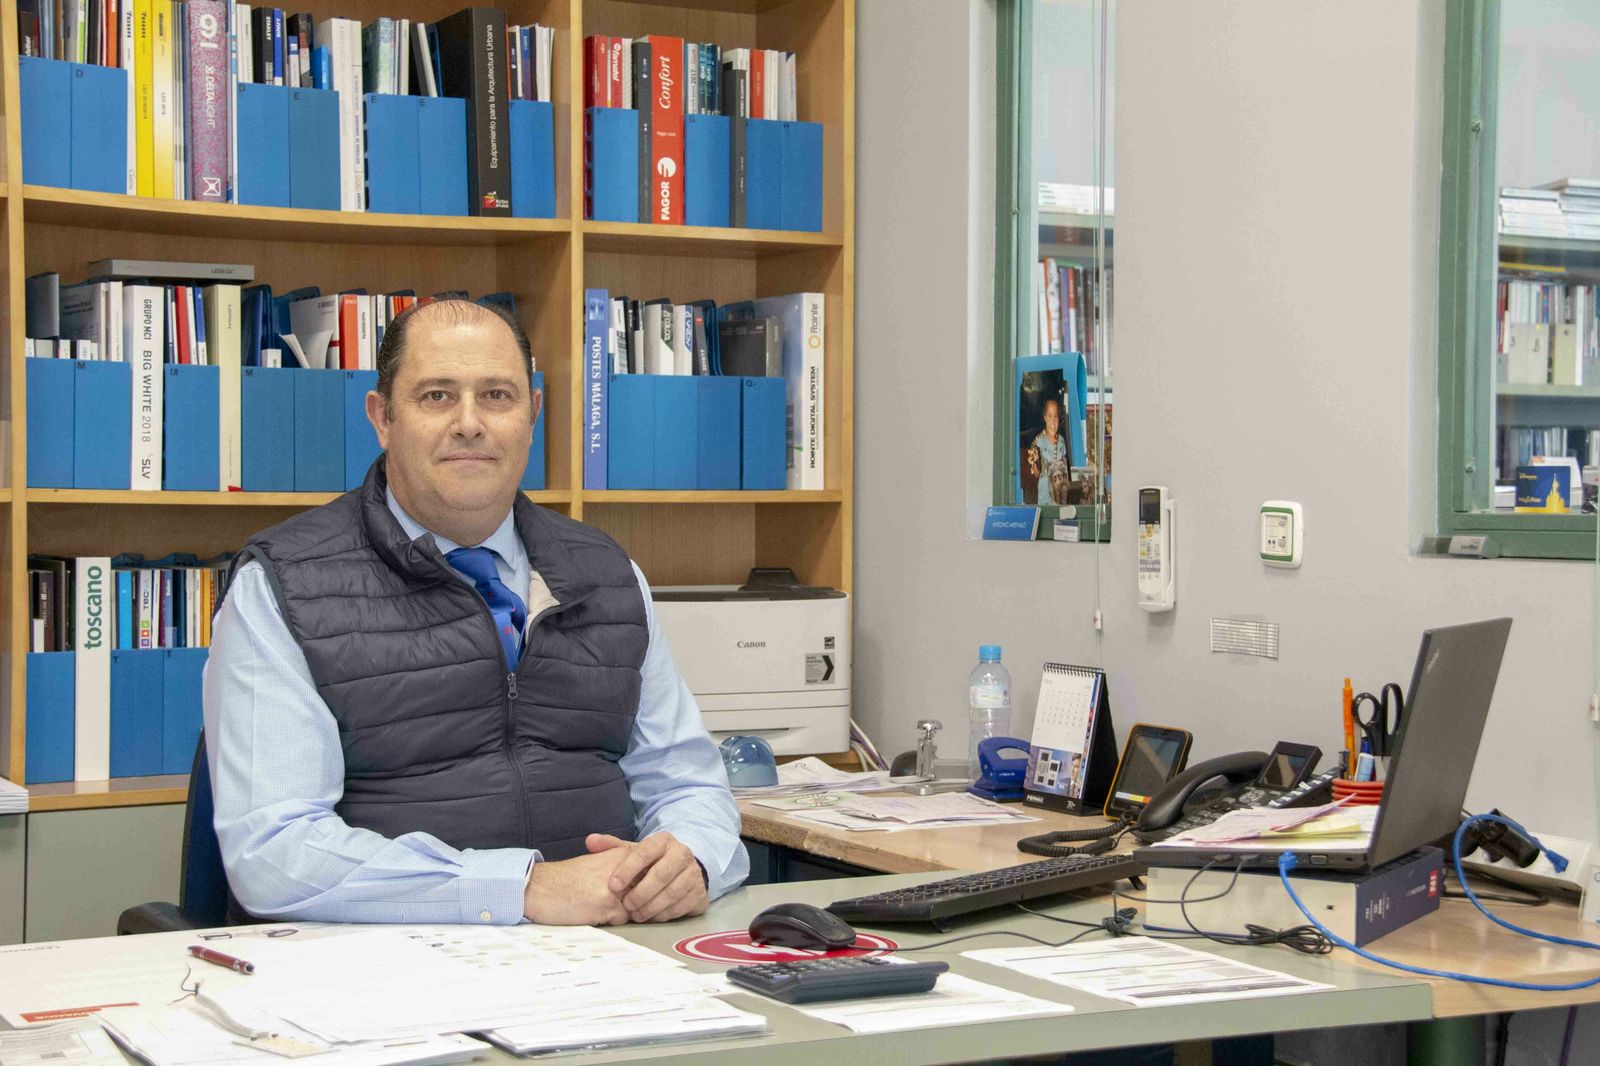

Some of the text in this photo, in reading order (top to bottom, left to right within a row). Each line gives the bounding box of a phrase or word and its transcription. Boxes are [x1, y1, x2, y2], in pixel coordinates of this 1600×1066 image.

[487, 52, 495, 95] Arquitectura
[658, 56, 674, 109] Confort
[489, 104, 497, 120] para
[490, 121, 498, 169] Equipamiento
[661, 181, 671, 221] FAGOR
[143, 298, 152, 325] GRUPO
[809, 303, 819, 334] Rointe
[141, 350, 152, 442] BIG WHITE 2018
[591, 336, 602, 453] POSTES MÁLAGA, S.L.
[141, 458, 151, 479] SLV
[84, 565, 102, 650] toscano
